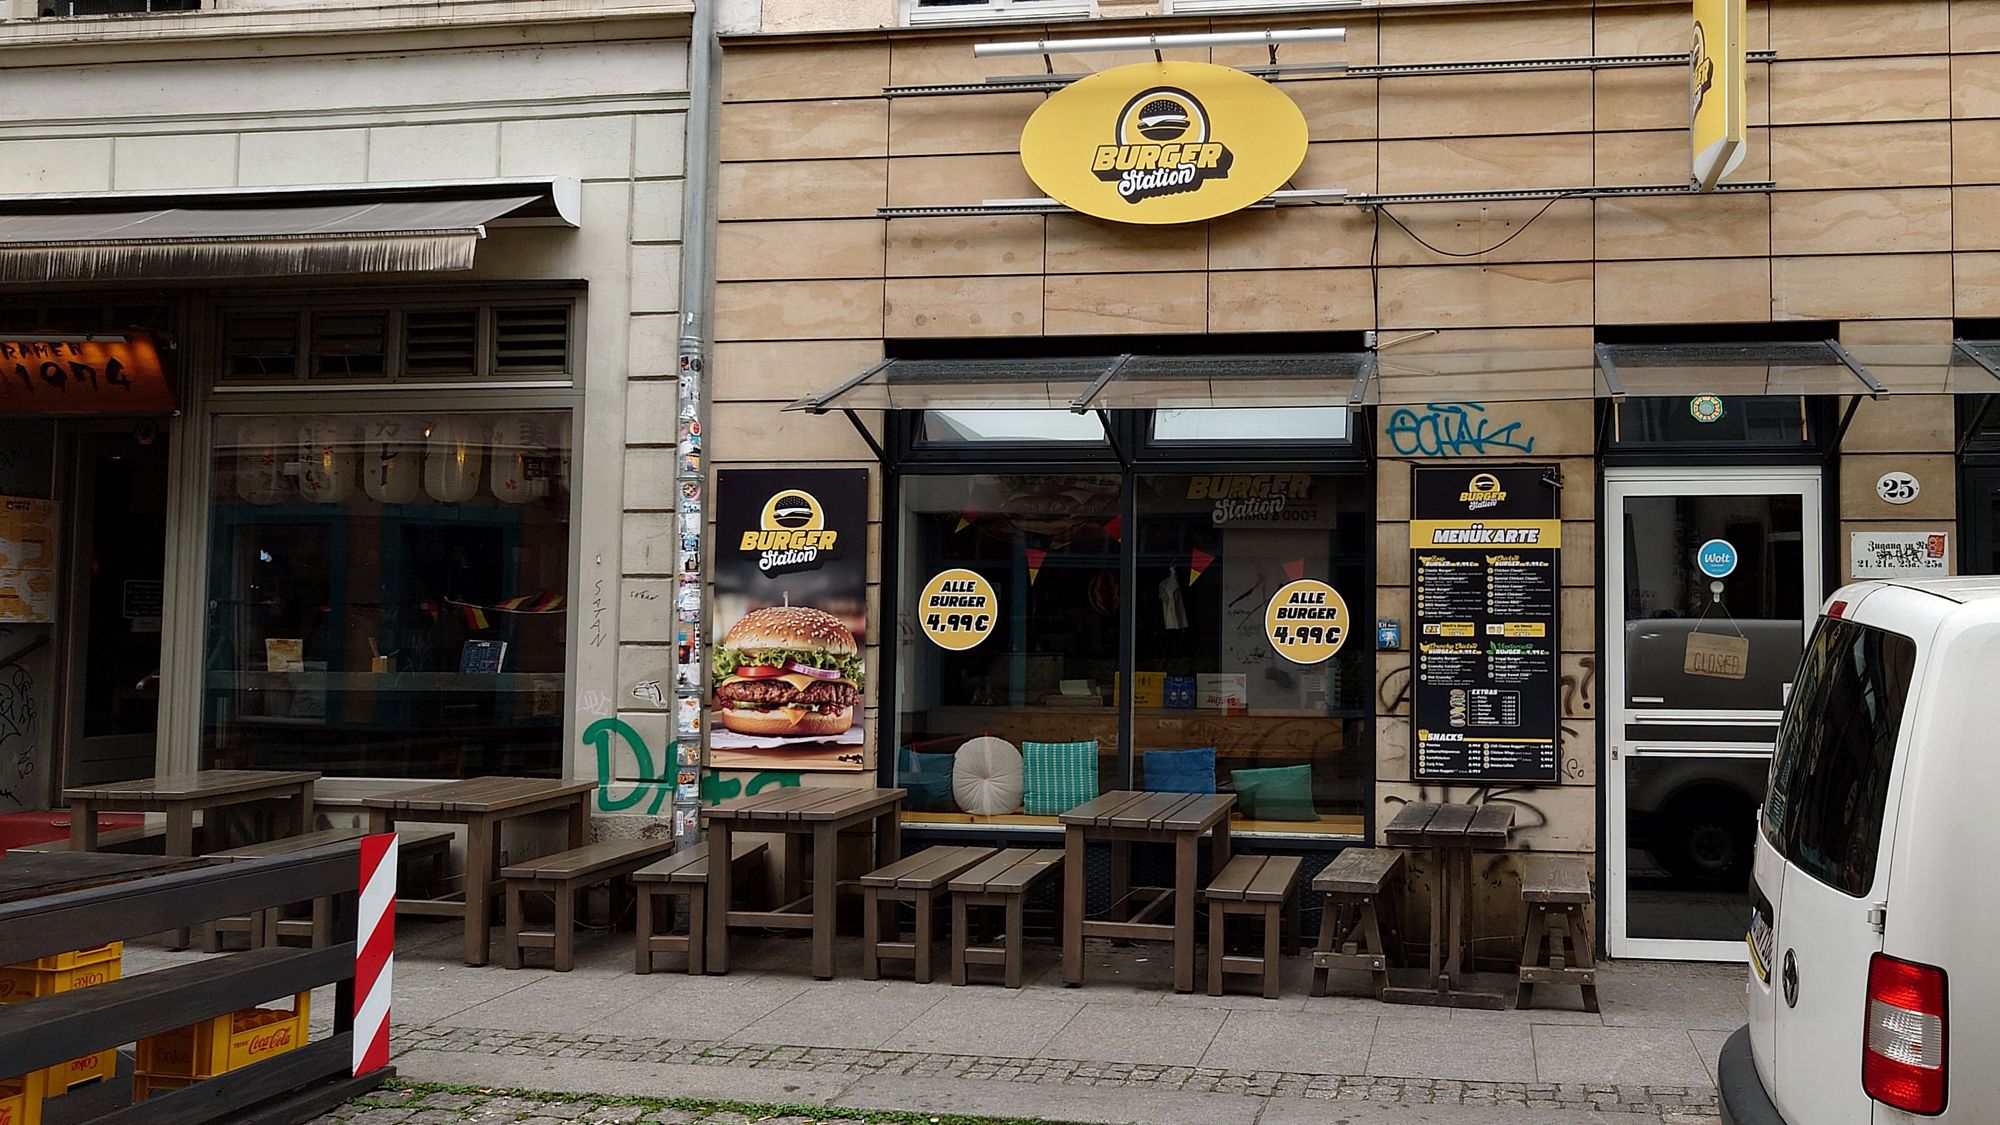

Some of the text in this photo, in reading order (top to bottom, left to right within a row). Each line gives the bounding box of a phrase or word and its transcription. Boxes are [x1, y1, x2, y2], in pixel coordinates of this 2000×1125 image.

[1092, 142, 1223, 172] BURGER
[1117, 162, 1196, 196] Station
[1, 342, 82, 360] RAMEN
[15, 356, 132, 393] 1974
[1187, 475, 1312, 499] BURGER
[1459, 491, 1507, 502] BURGER
[1883, 479, 1915, 499] 25
[1212, 493, 1286, 524] Station
[740, 531, 838, 551] BURGER
[1432, 523, 1540, 544] MENÜKARTE
[759, 545, 818, 571] Station
[1704, 552, 1731, 563] Wolt
[940, 581, 976, 593] ALLE
[929, 596, 986, 608] BURGER
[1289, 592, 1326, 604] ALLE
[590, 580, 607, 648] SATAN
[1276, 607, 1338, 620] BURGER
[1694, 652, 1741, 676] CLOSED
[1427, 733, 1464, 742] SNACKS
[71, 1055, 99, 1072] Coke
